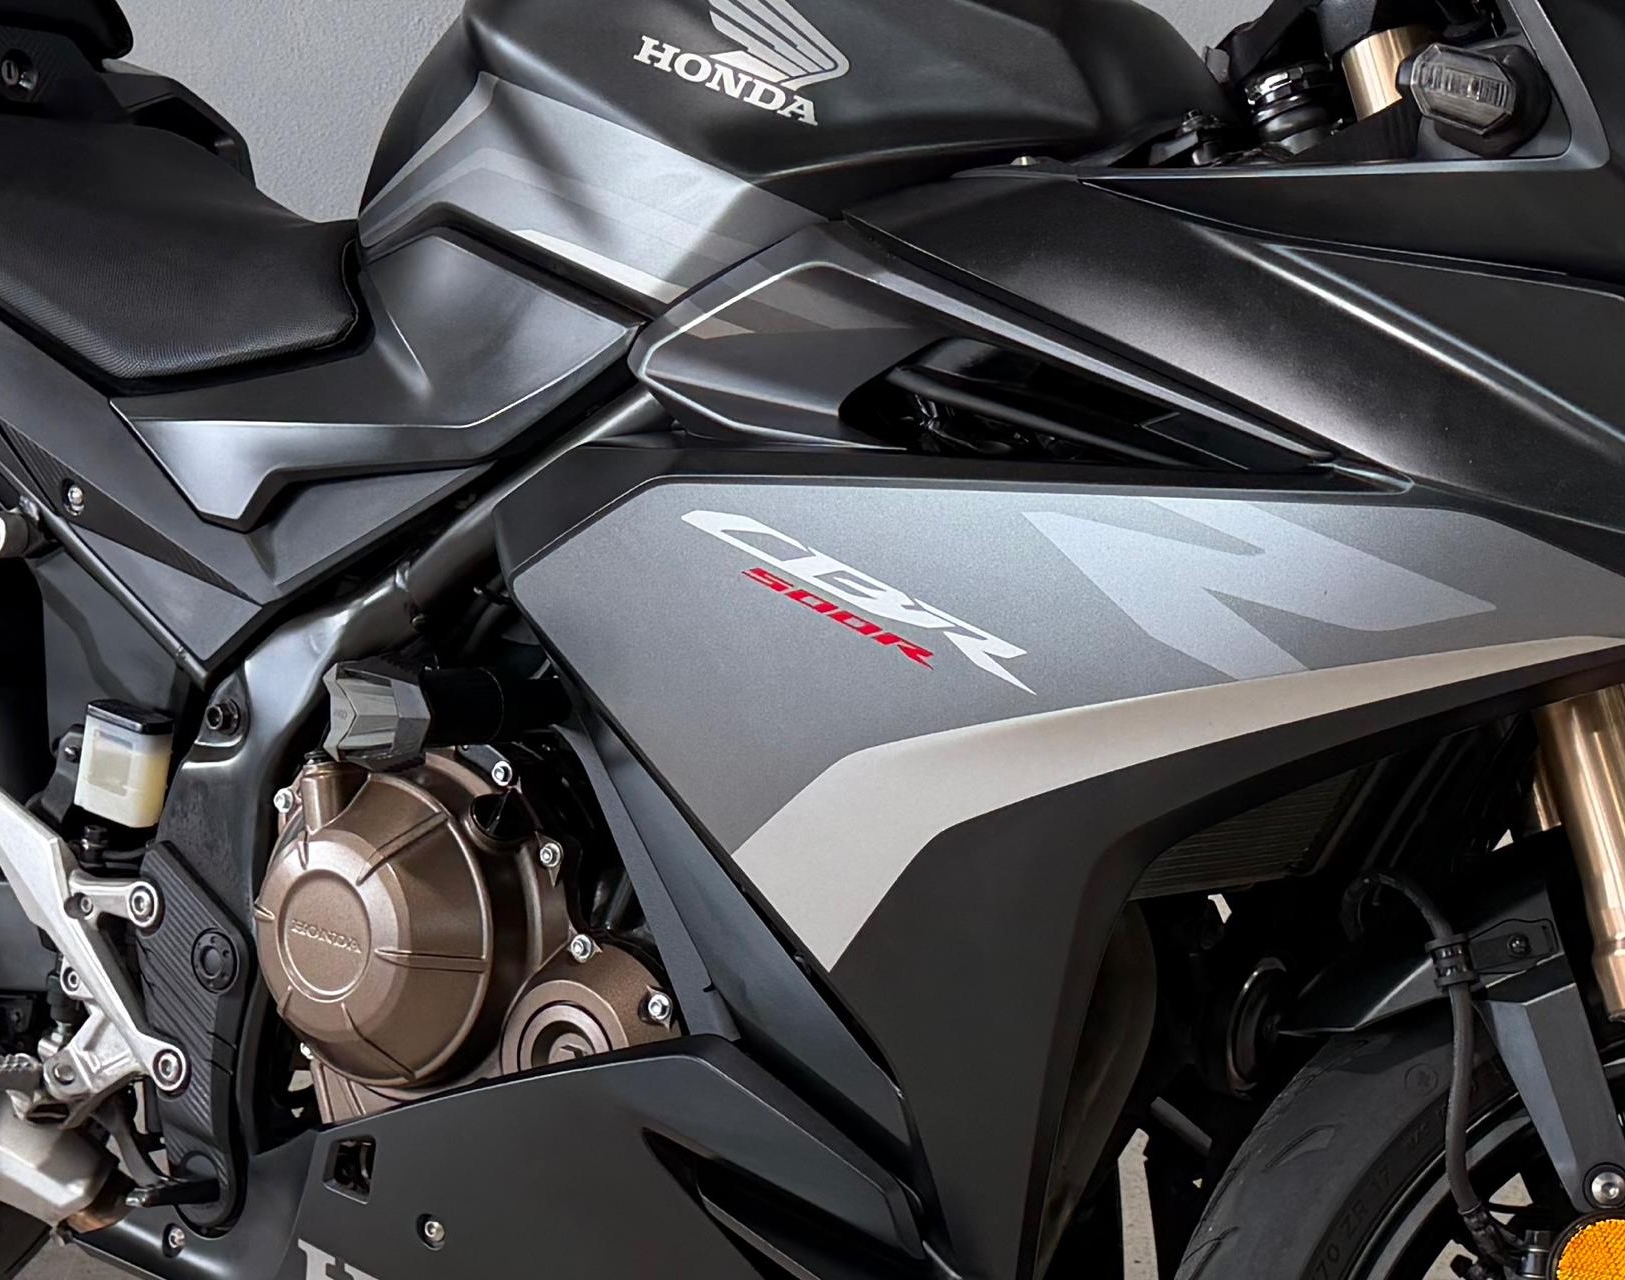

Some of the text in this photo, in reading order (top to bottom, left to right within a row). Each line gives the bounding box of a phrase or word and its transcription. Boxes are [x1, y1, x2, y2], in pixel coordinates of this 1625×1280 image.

[632, 35, 818, 126] HONDA
[681, 509, 1037, 696] CBR
[741, 566, 935, 671] 500R
[289, 918, 363, 956] HONDA
